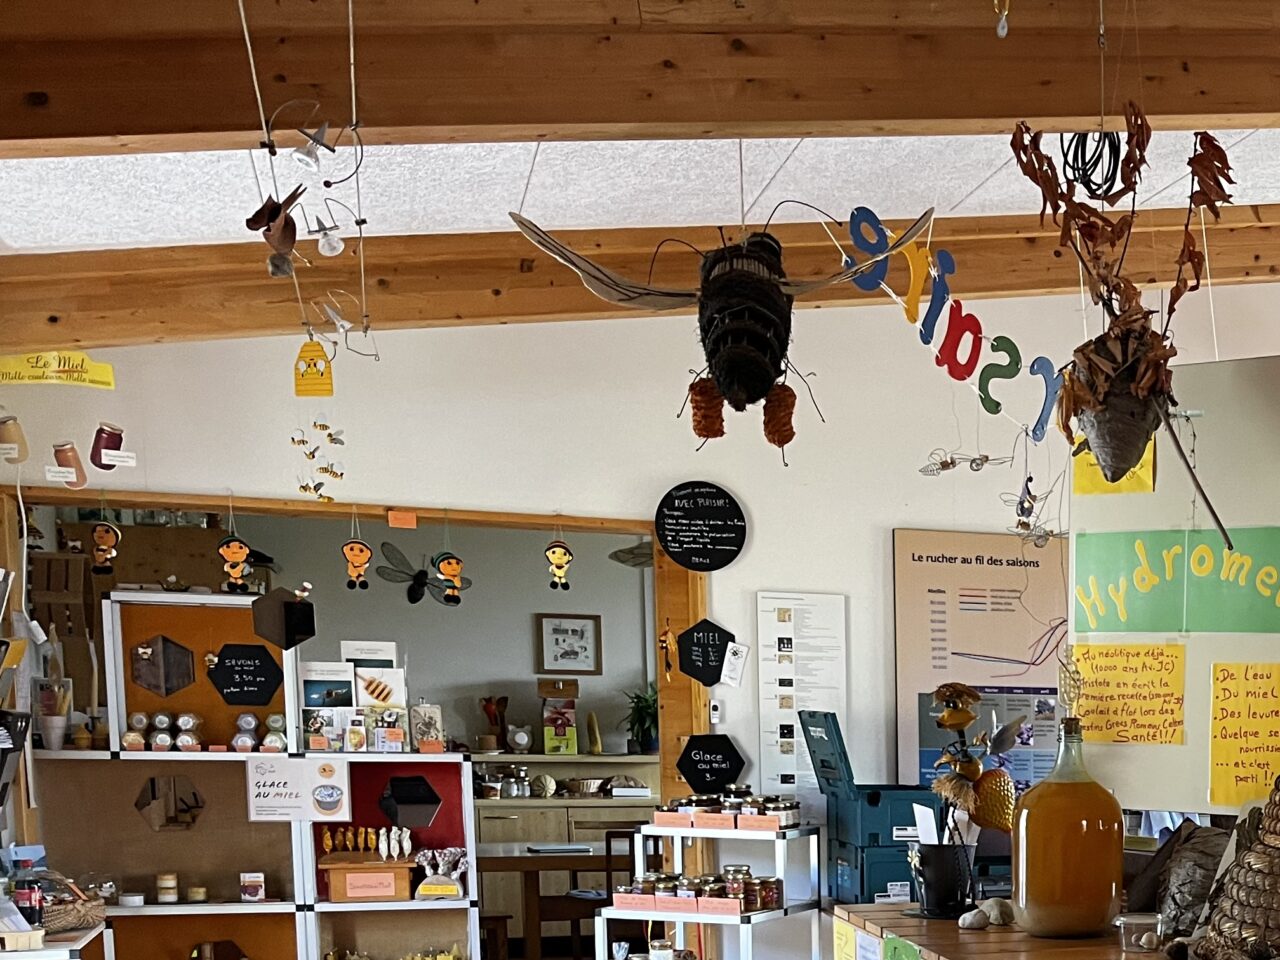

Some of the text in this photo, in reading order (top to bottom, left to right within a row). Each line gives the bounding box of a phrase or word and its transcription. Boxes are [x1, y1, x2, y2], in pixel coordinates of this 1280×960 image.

[26, 354, 88, 370] Le Miel
[912, 553, 1040, 568] Le rucher au fil des saisons
[693, 632, 721, 645] MIEL
[1122, 665, 1139, 674] ans
[1219, 665, 1272, 683] De l'eau
[1159, 677, 1170, 688] la
[1220, 686, 1279, 702] Du miel
[1219, 707, 1241, 722] Des
[1219, 726, 1260, 744] Quelque
[691, 750, 724, 761] Glace
[712, 761, 731, 769] miel
[255, 780, 289, 790] GLACE
[254, 791, 303, 799] AU MIEL
